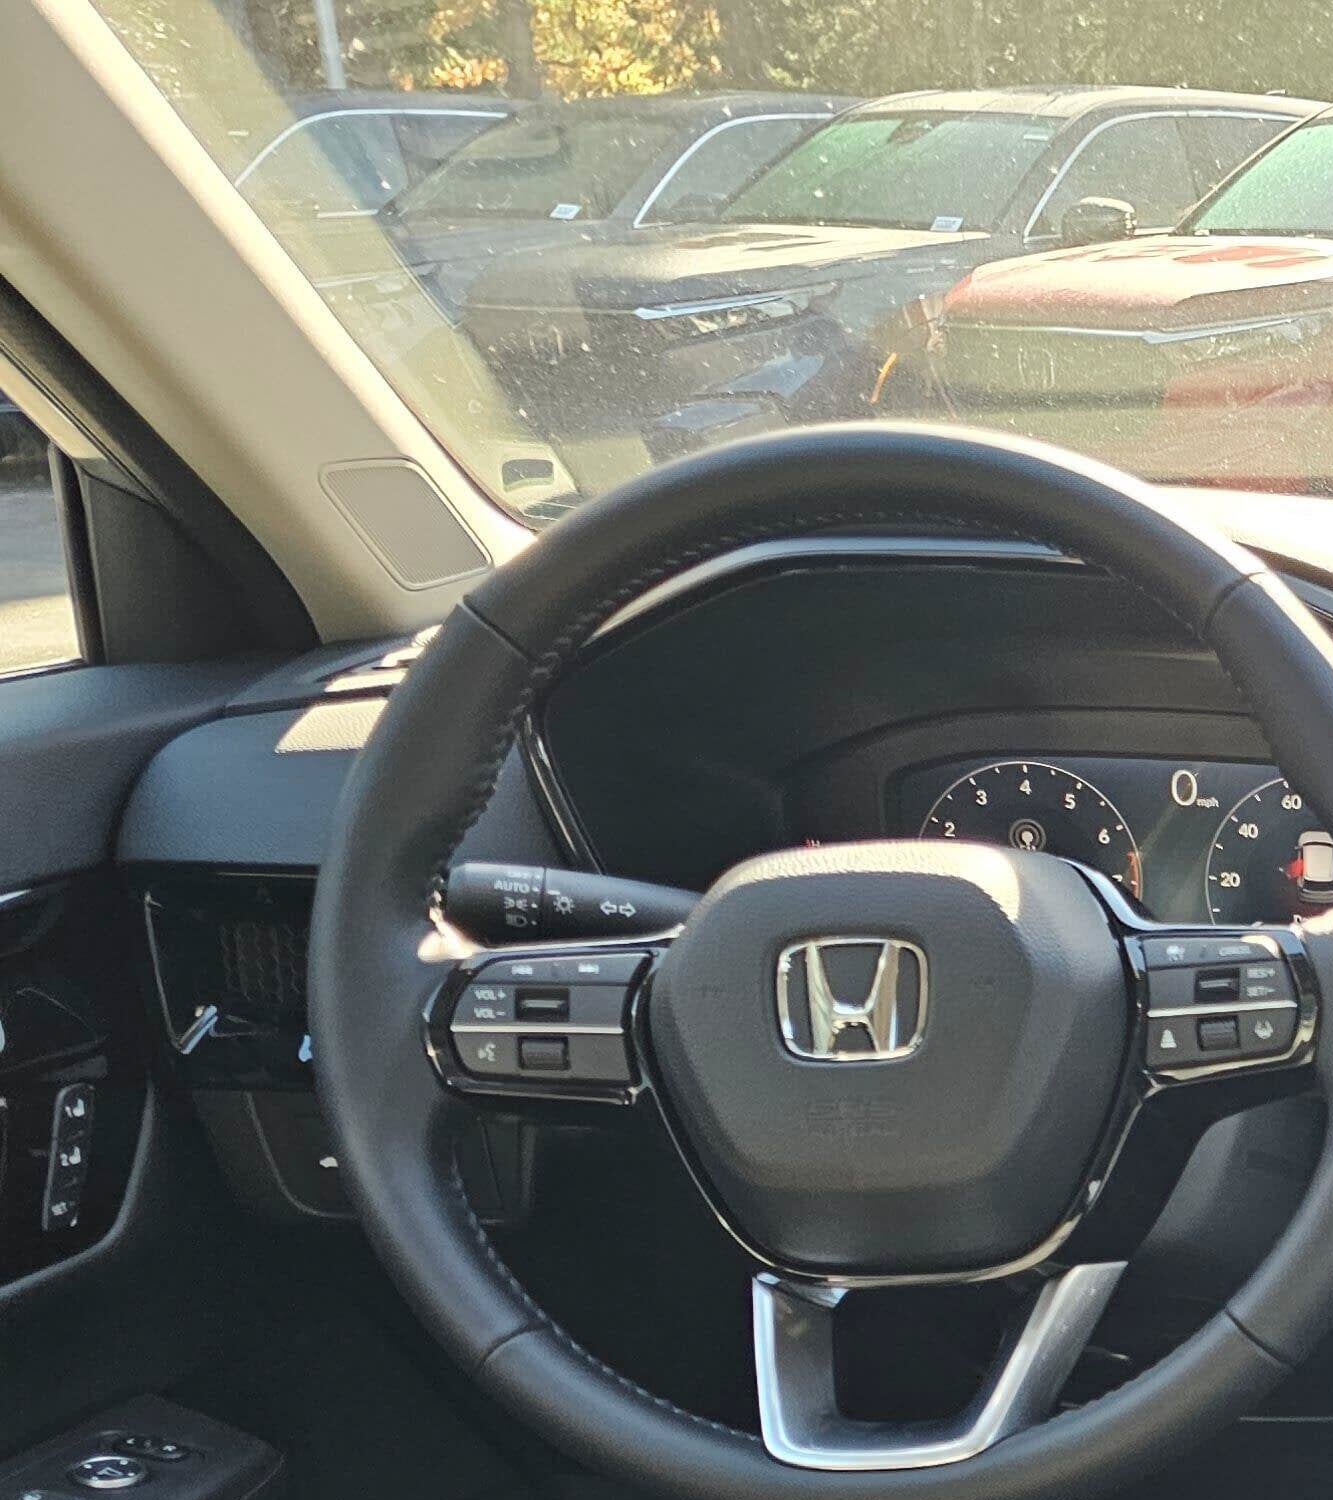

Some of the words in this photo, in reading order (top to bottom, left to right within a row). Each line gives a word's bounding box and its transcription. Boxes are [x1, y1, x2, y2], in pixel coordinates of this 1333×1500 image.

[1019, 779, 1032, 795] 4
[1171, 769, 1198, 806] 0
[1197, 797, 1219, 809] mph
[975, 789, 988, 806] 3
[1064, 793, 1076, 810] 5
[1281, 794, 1302, 810] 60
[944, 821, 956, 838] 2
[1098, 828, 1110, 845] 6
[1238, 823, 1259, 839] 40
[494, 880, 530, 894] AUTO
[1220, 872, 1241, 888] 20
